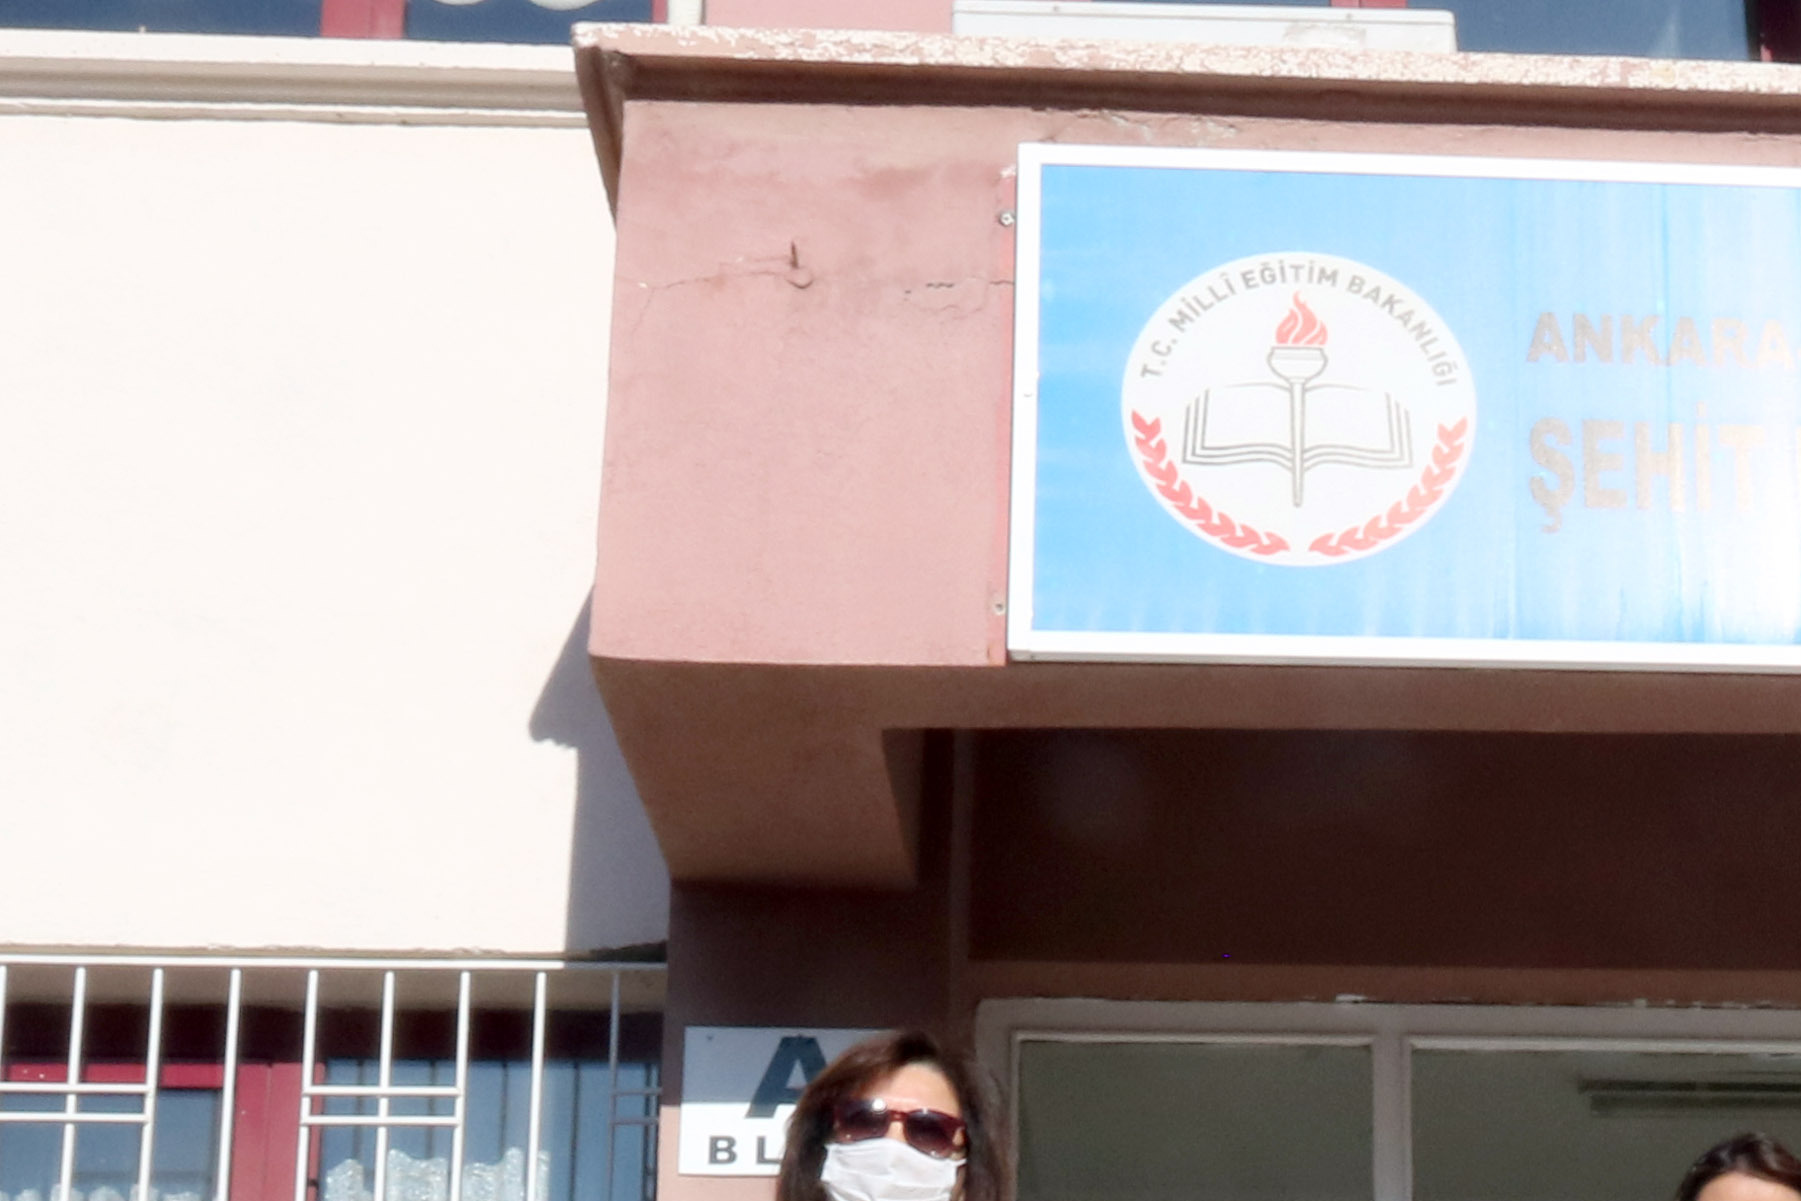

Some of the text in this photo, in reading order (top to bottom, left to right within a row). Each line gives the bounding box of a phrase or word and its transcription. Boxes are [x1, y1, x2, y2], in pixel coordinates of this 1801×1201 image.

[1240, 260, 1339, 290] EĞİTİM
[1346, 274, 1457, 387] BAKANLIĞI
[1528, 403, 1765, 534] ŞEHİT
[745, 1036, 828, 1119] A
